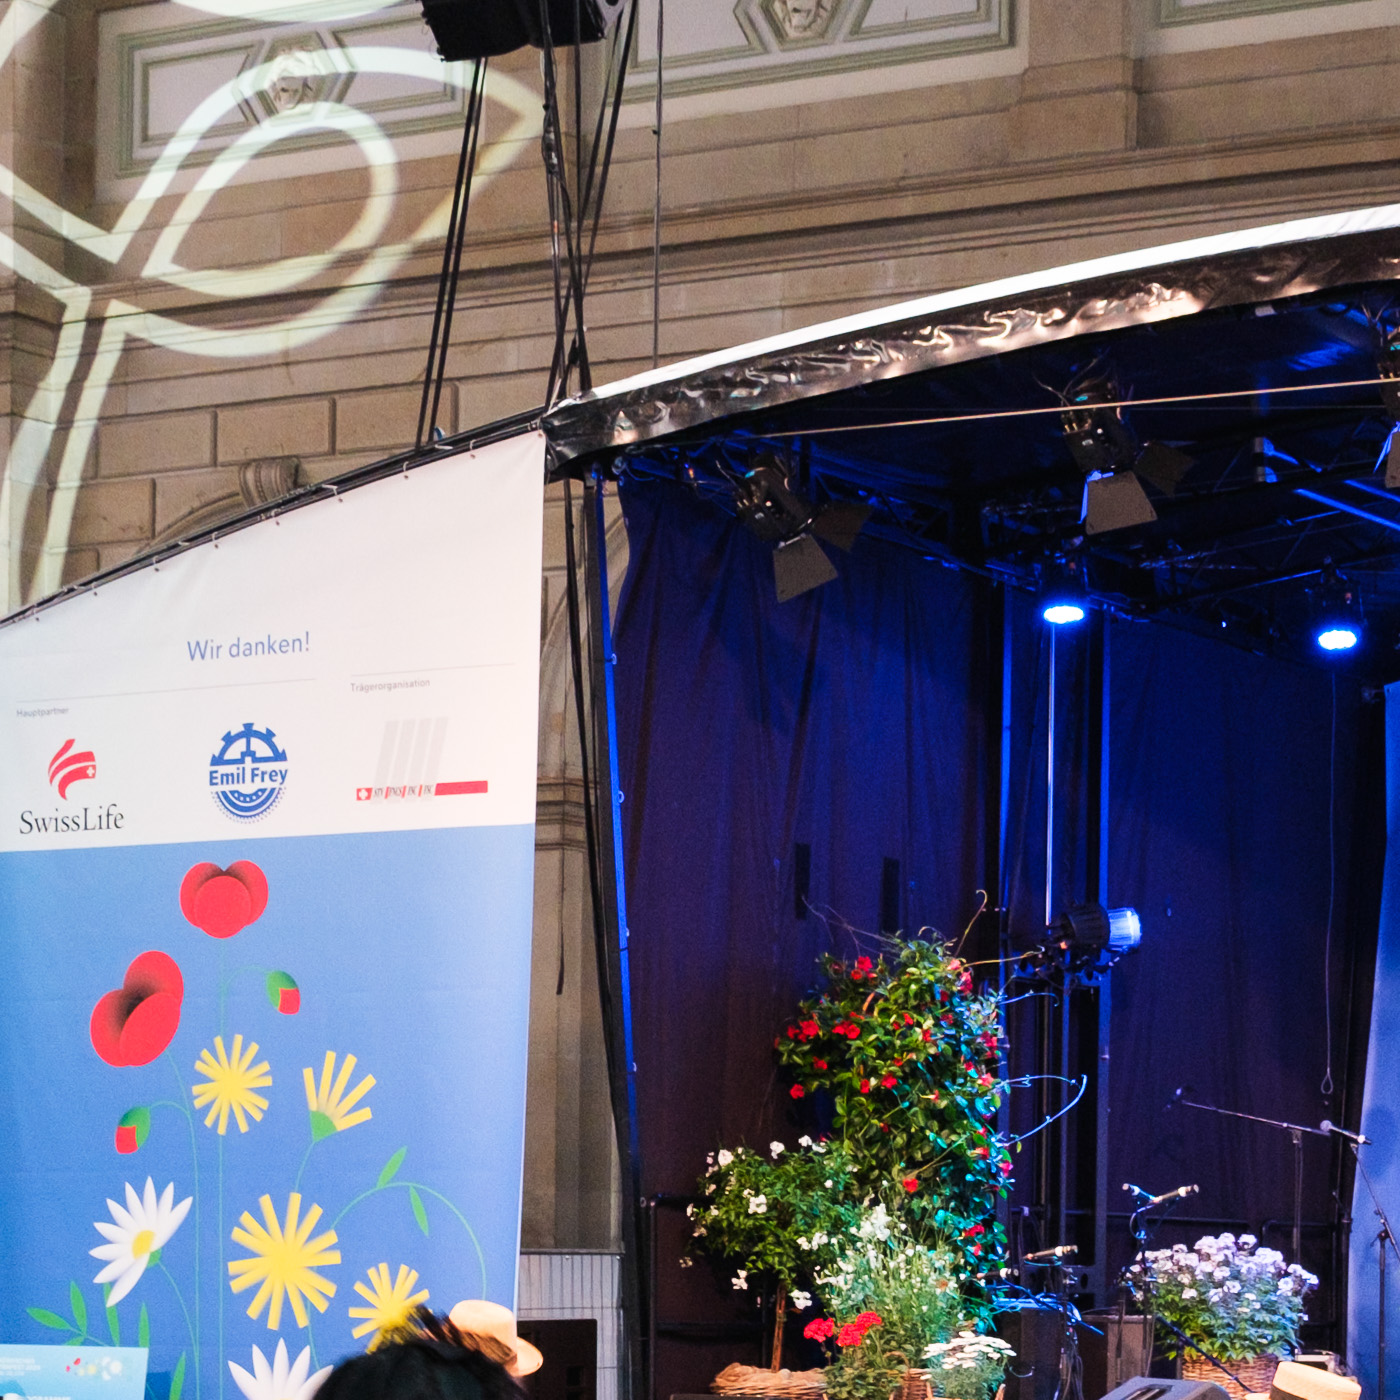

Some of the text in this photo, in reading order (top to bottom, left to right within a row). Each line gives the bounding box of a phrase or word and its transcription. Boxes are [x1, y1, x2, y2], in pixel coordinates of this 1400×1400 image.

[187, 631, 310, 661] Wir danken!
[350, 679, 431, 693] Trägerorganisation
[16, 706, 70, 719] Hauptpartner
[208, 766, 288, 788] Emil Frey
[19, 803, 125, 835] SwissLife
